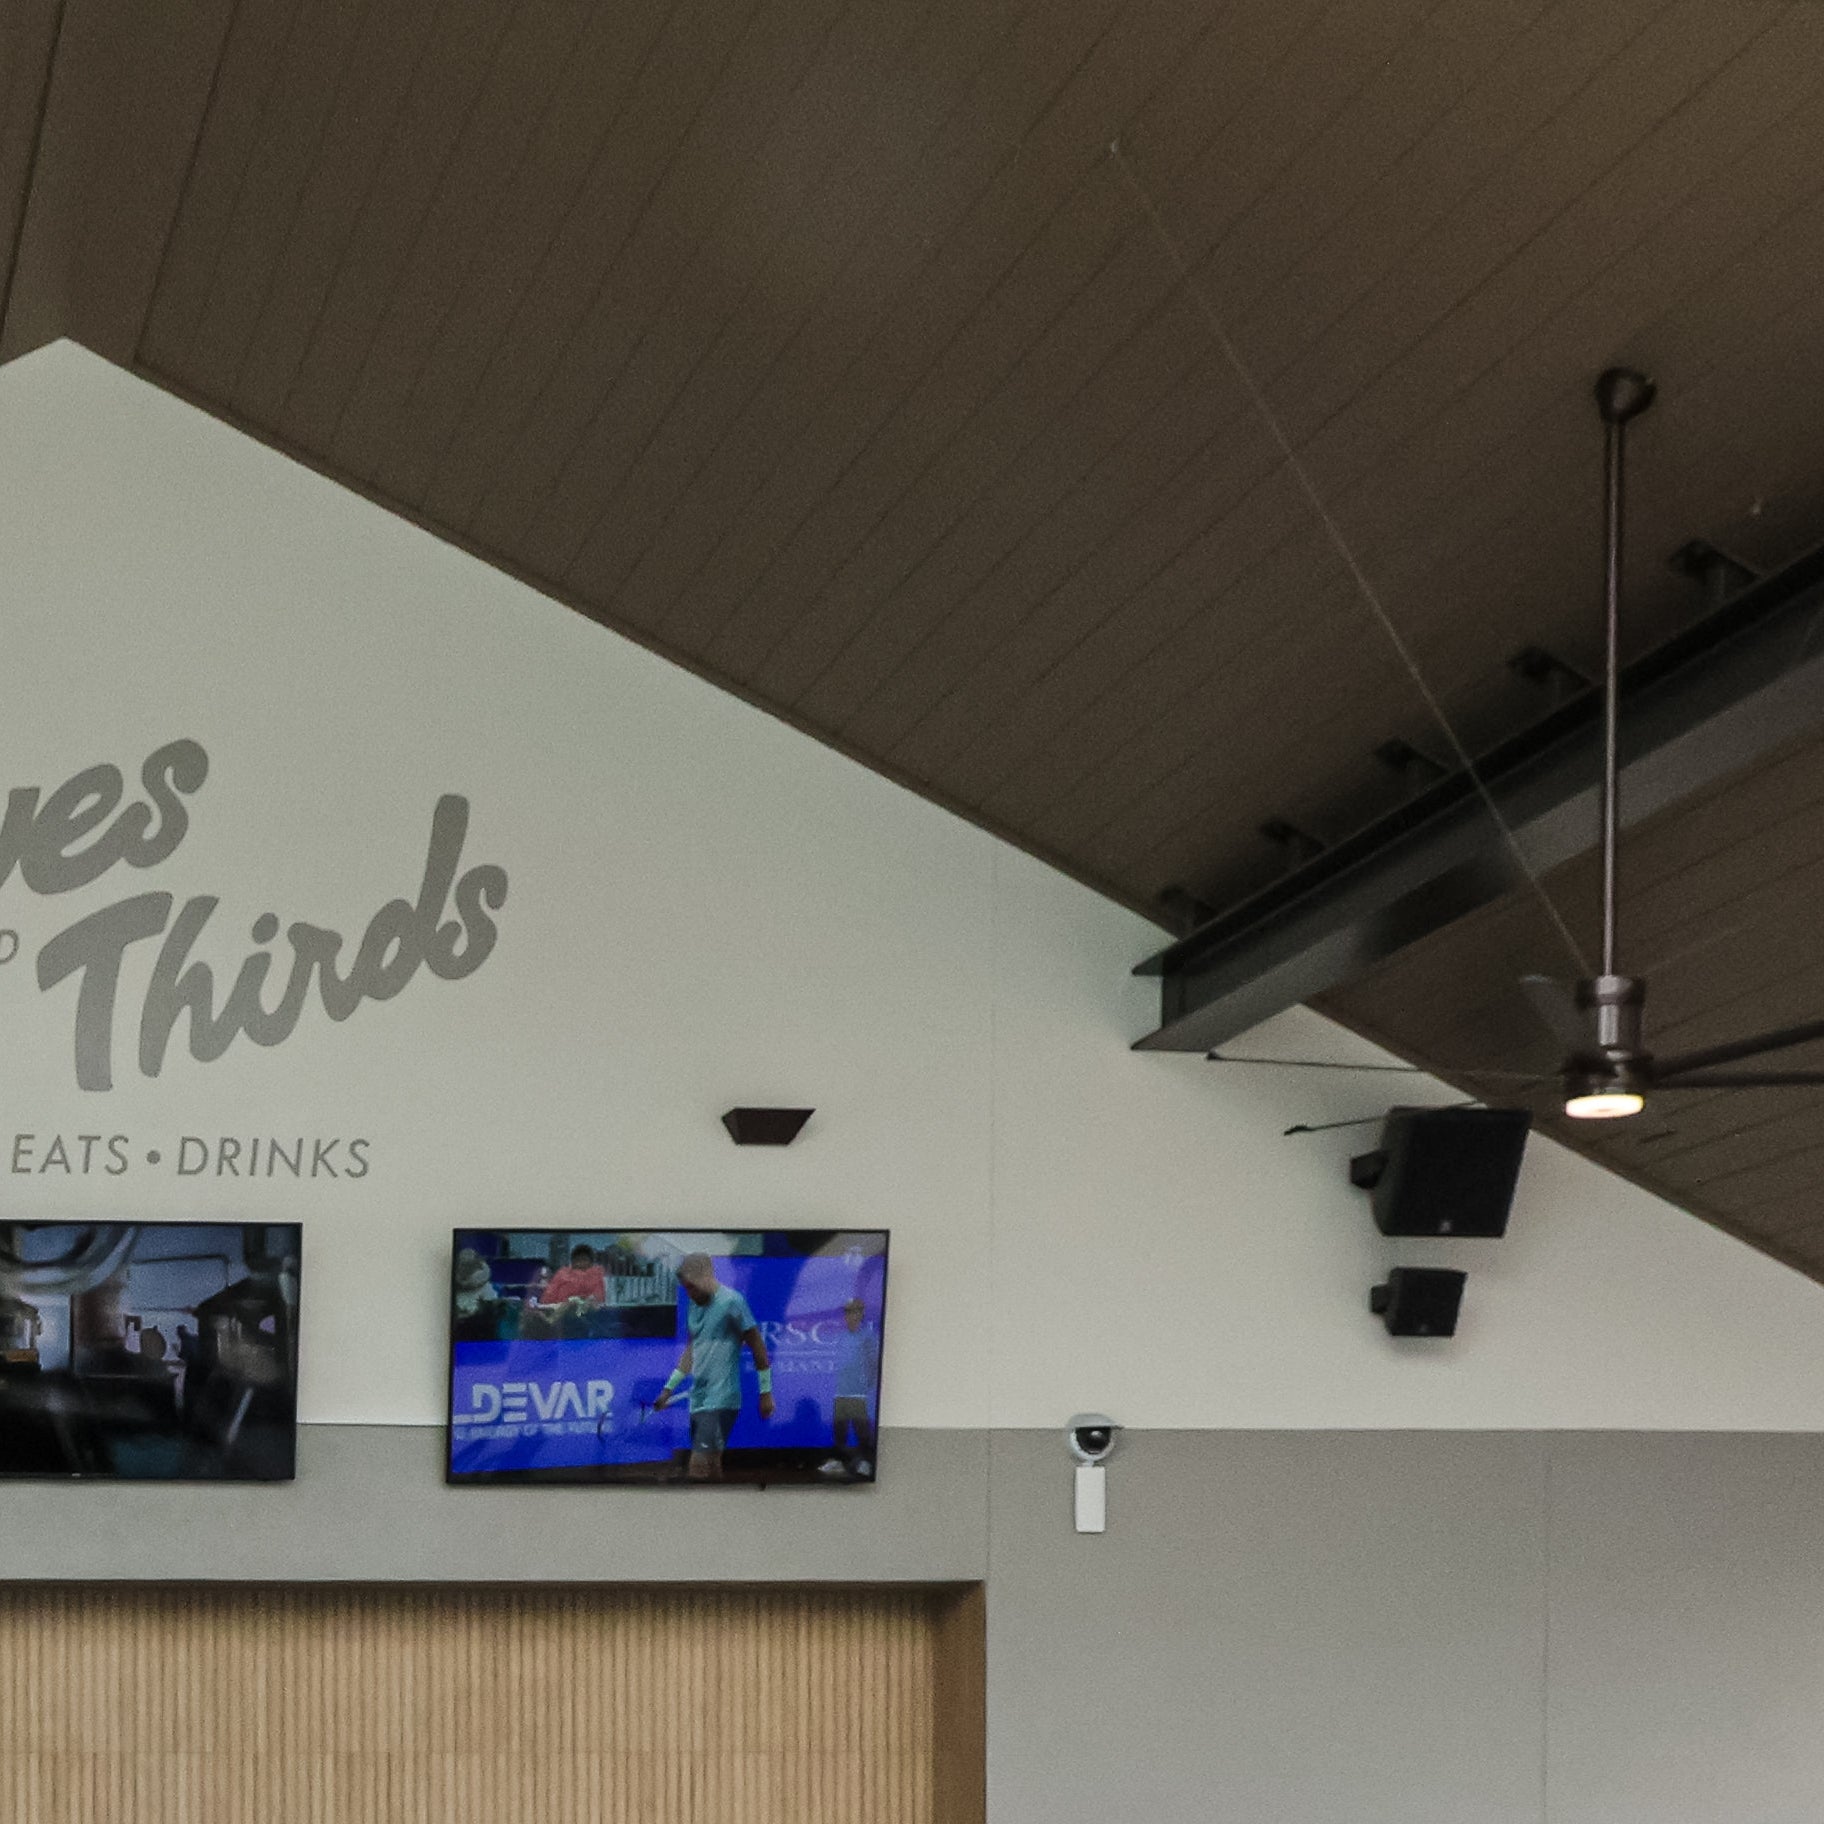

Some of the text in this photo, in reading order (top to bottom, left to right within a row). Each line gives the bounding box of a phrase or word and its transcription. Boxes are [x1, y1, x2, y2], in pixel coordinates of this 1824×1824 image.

[35, 793, 509, 1093] Thirds
[10, 1134, 131, 1176] EATS
[176, 1136, 372, 1179] DRINKS
[453, 1380, 614, 1424] DEVAR
